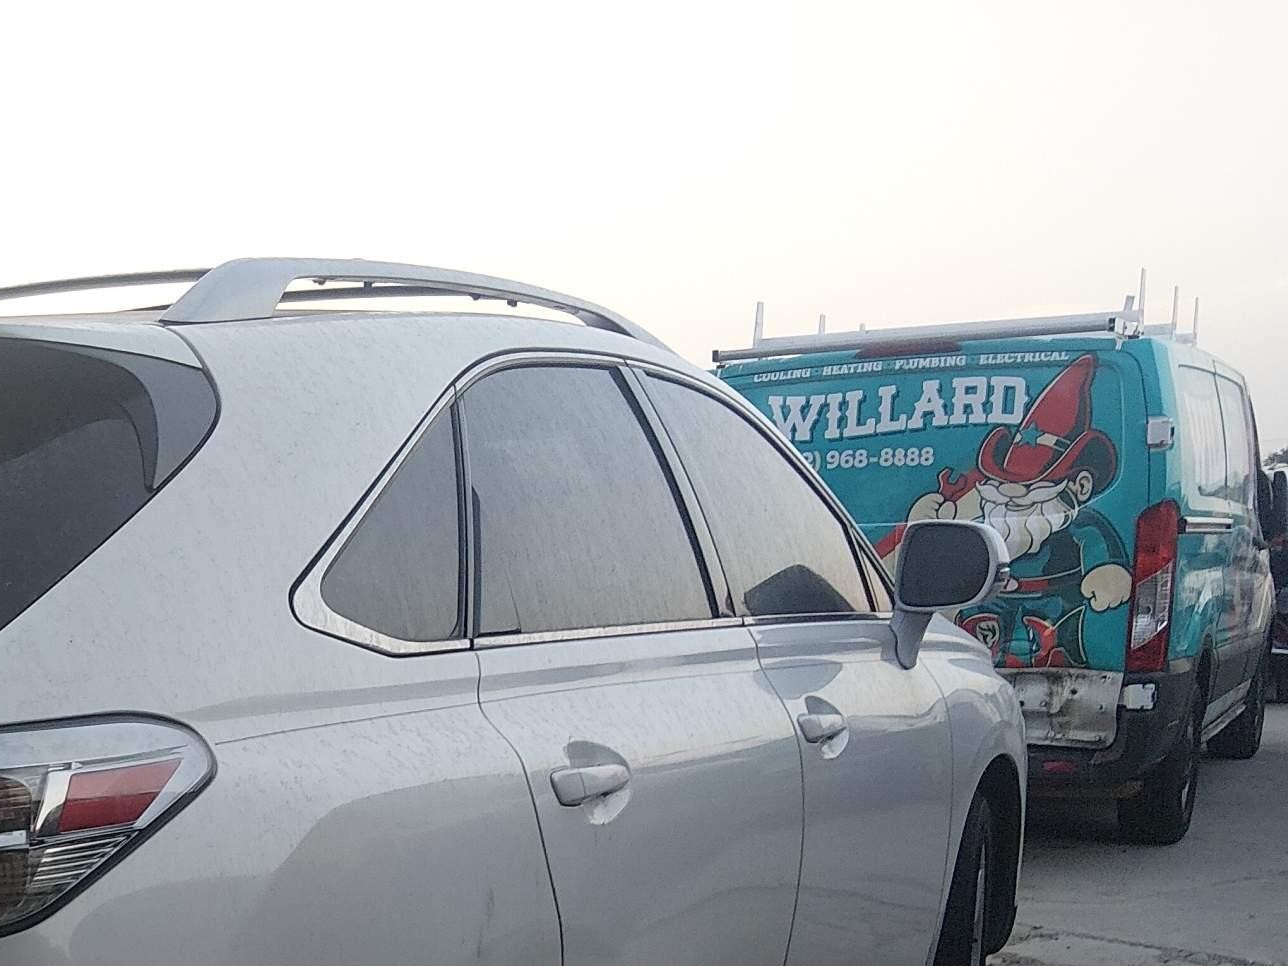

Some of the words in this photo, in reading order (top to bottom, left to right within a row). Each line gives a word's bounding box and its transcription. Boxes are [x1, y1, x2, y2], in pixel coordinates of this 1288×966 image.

[753, 367, 811, 383] COOLING
[822, 360, 883, 376] HEATING
[894, 354, 967, 370] PLUMBING
[978, 350, 1070, 366] ELECTRICAL
[768, 376, 1031, 442] WILLARD
[825, 446, 935, 470] 968-8888
